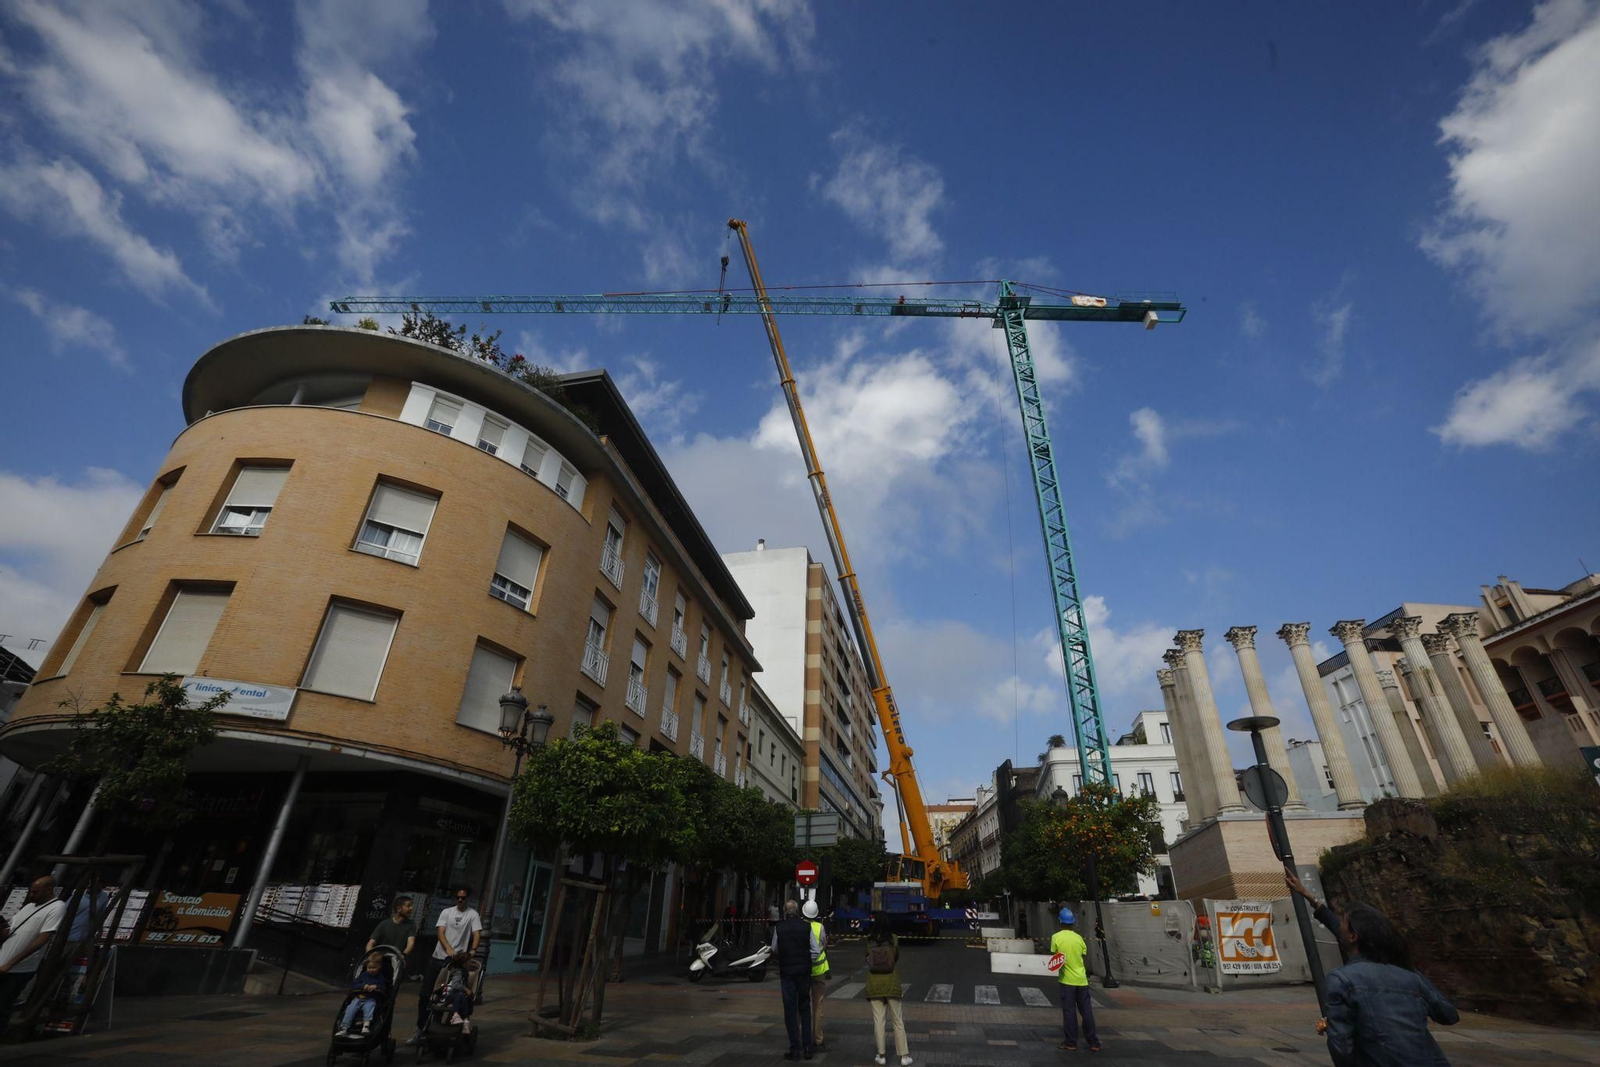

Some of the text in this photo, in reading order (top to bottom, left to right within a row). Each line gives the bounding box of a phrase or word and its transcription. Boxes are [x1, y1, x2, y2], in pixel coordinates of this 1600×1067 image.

[885, 694, 905, 745] MOLERO
[162, 890, 203, 905] Servicio
[177, 904, 232, 918] a domicilio
[146, 932, 221, 944] 957 391 613
[1048, 955, 1064, 968] STOP
